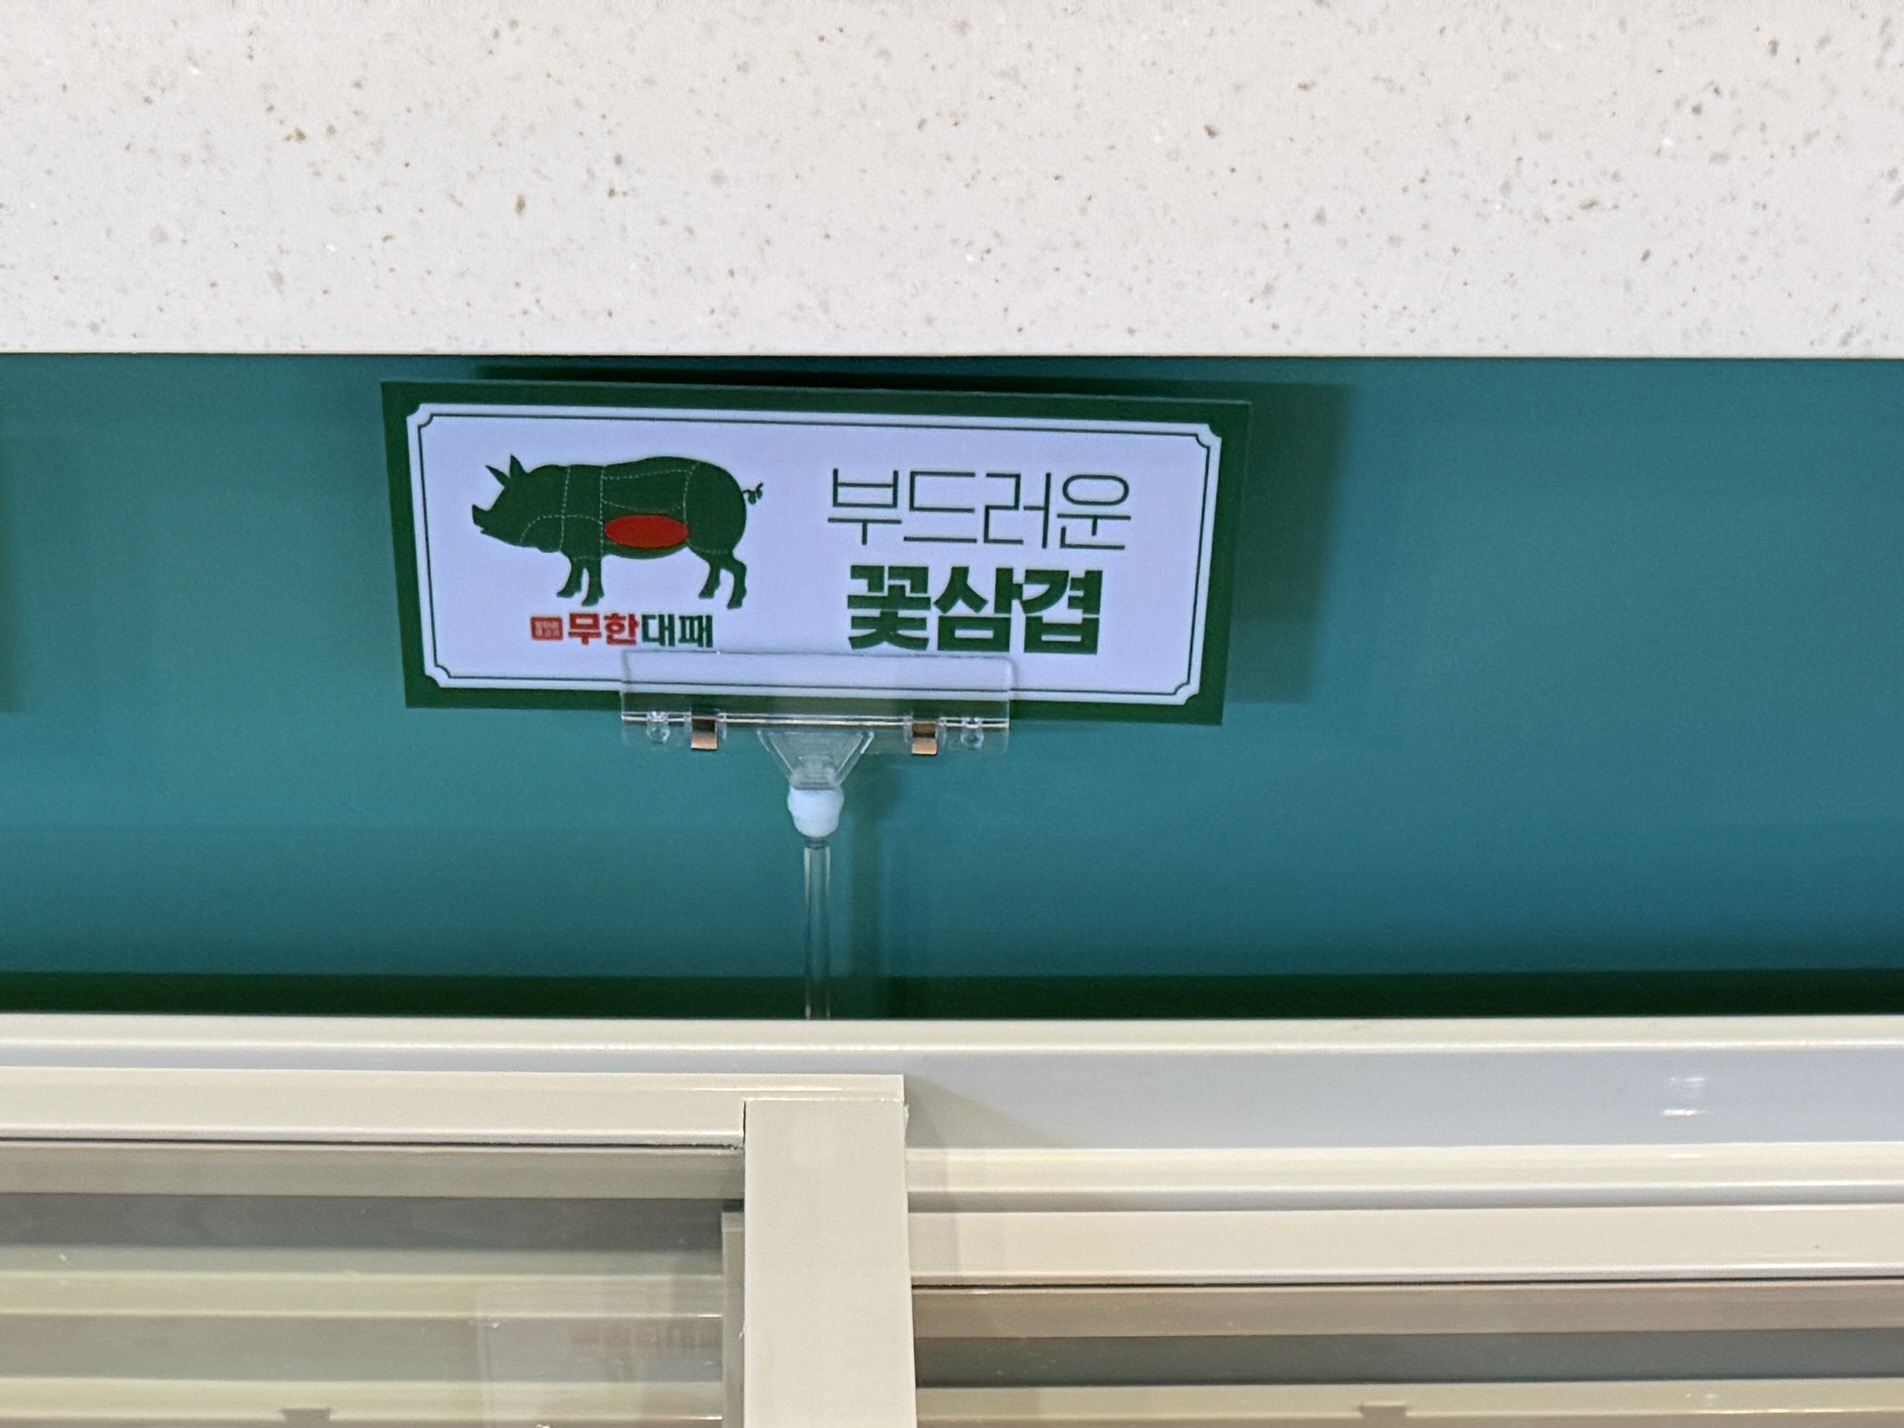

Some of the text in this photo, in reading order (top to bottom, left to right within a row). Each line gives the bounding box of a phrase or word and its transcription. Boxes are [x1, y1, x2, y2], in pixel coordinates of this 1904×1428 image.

[827, 467, 1133, 551] 부드러운
[568, 612, 714, 648] 무한대패
[846, 564, 1105, 656] 꽃삼겹
